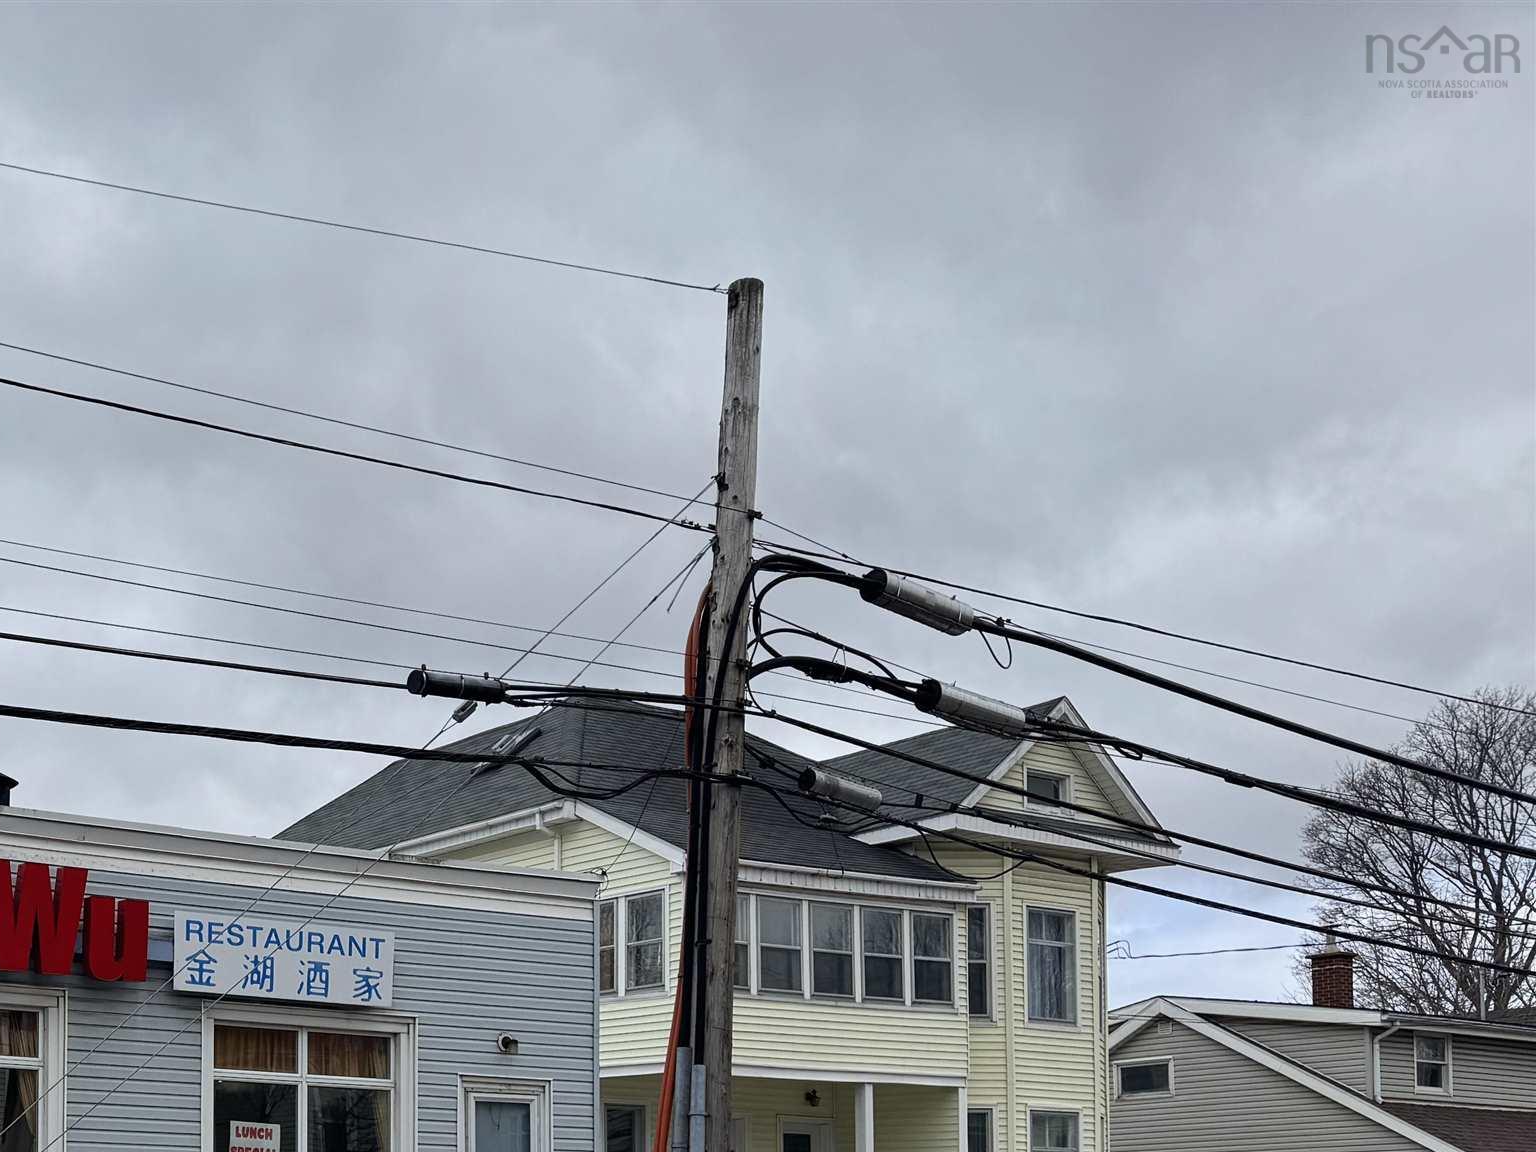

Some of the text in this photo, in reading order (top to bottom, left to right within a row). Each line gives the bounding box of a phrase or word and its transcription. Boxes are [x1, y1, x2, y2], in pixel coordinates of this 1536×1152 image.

[185, 919, 386, 960] RESTAURANT
[184, 949, 384, 1002] 金湖酒家
[235, 1126, 273, 1140] LUNCH
